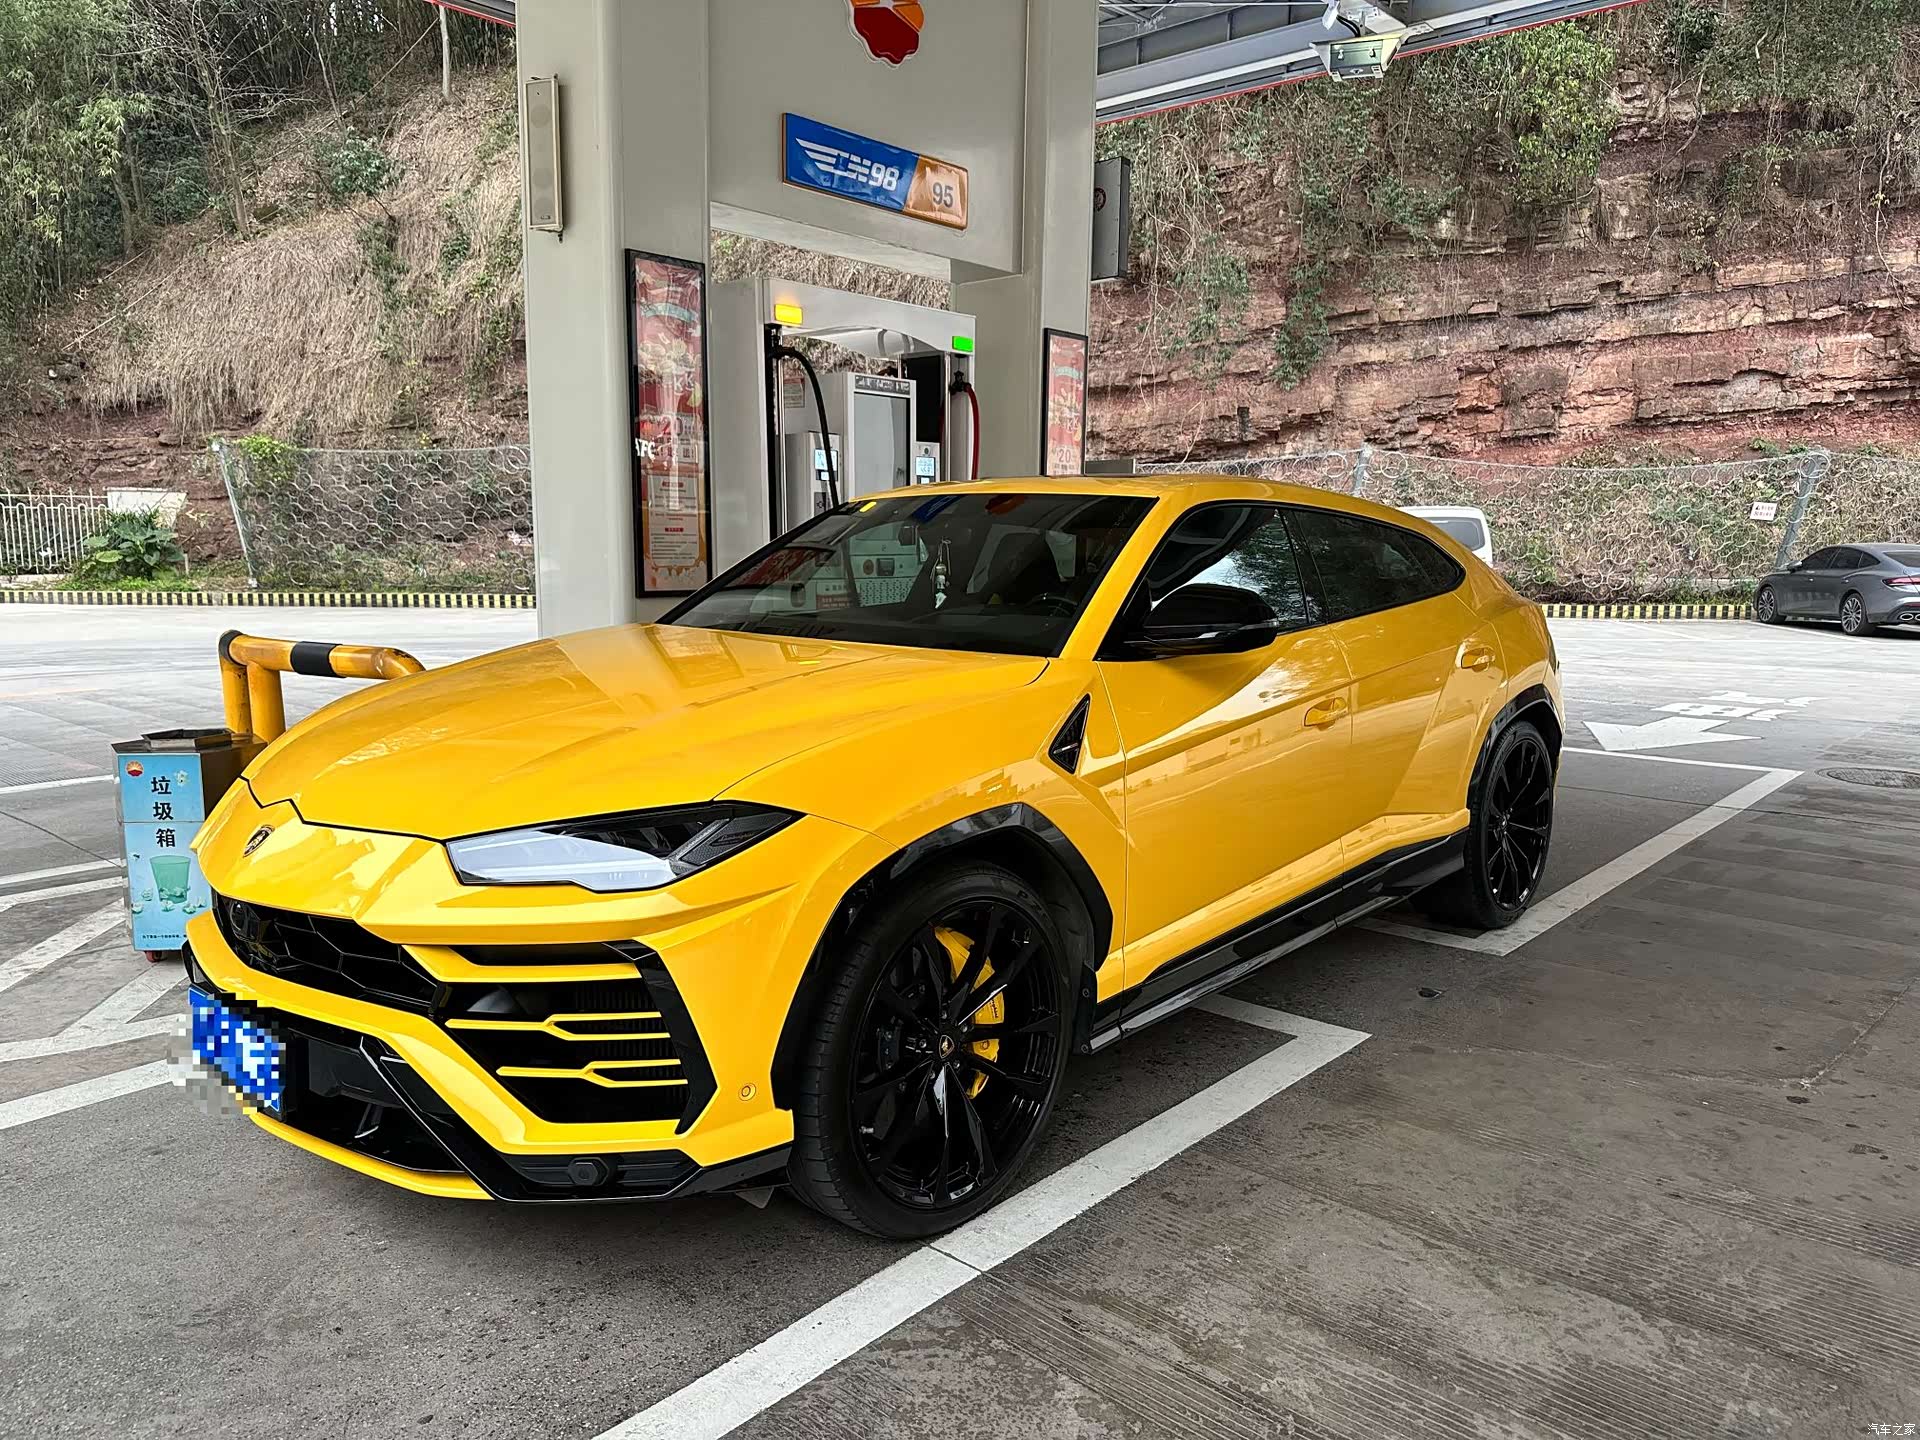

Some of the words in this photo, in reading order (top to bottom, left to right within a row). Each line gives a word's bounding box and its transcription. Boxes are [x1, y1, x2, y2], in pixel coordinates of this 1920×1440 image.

[932, 182, 953, 208] 95
[151, 776, 176, 848] 垃圾箱
